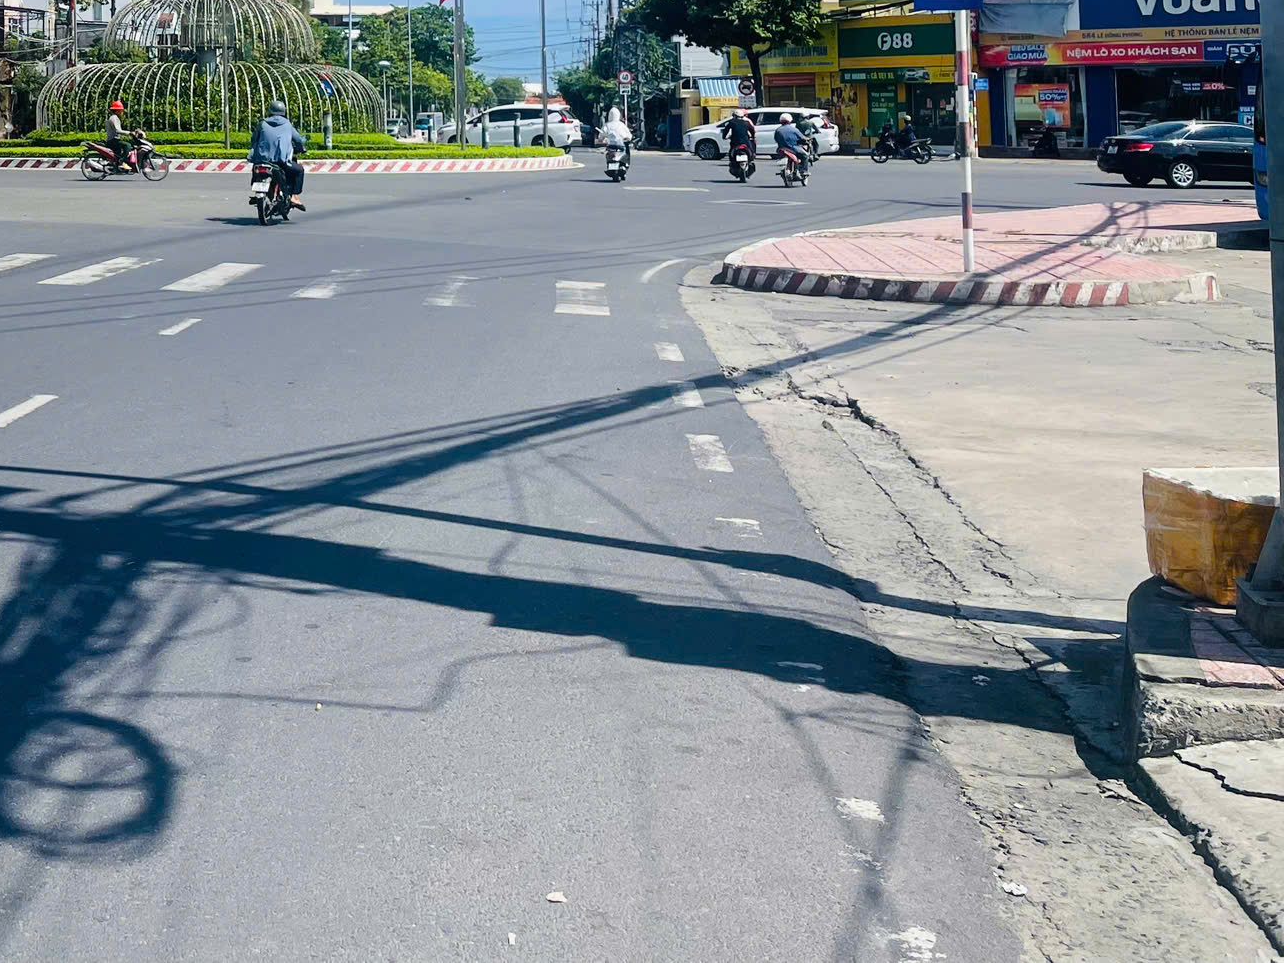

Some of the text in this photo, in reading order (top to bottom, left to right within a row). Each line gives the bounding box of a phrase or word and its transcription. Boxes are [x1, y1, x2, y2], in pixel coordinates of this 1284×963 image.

[877, 32, 913, 50] F88
[1067, 43, 1197, 60] NỆM LÒ XO KHÁCH SẠN
